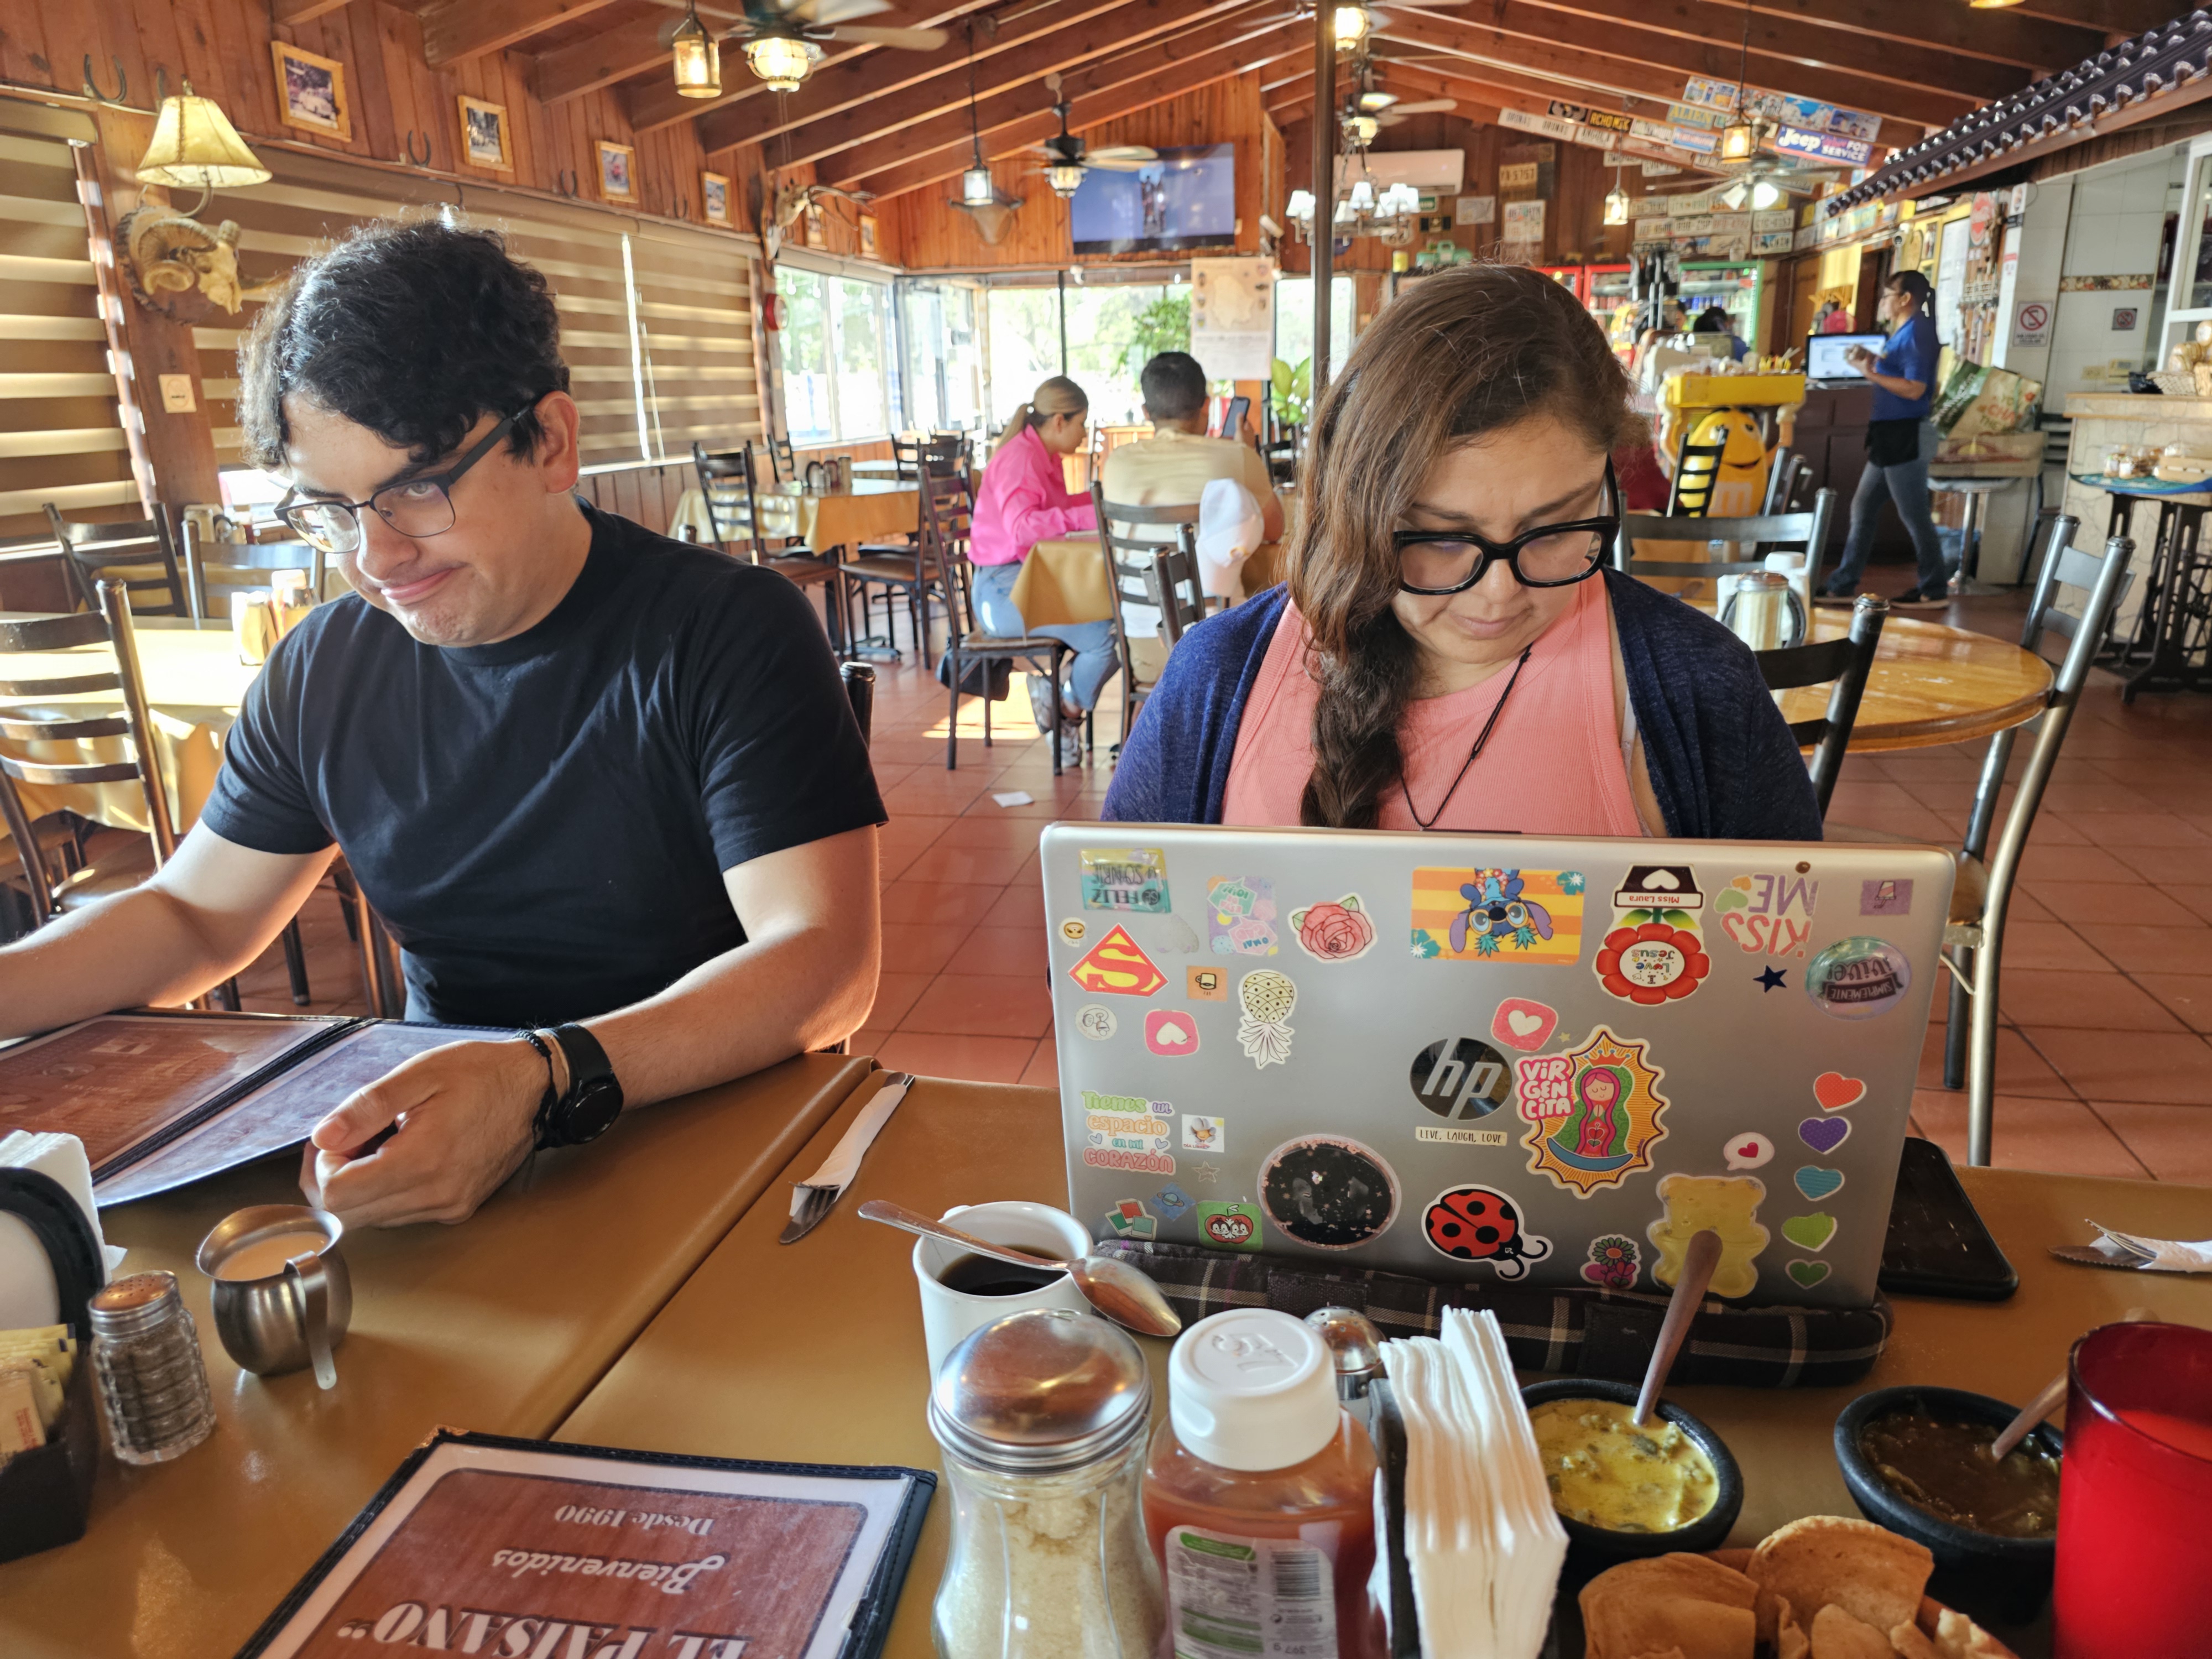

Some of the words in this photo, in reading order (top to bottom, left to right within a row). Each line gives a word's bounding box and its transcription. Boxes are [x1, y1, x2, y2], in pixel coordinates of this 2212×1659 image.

[1821, 145, 1866, 162] SERVICE
[1846, 140, 1869, 153] FOR
[1091, 889, 1139, 904] FELIZ
[1629, 895, 1655, 904] Laura
[1657, 895, 1679, 904] Miss
[1748, 875, 1819, 916] ME
[1242, 938, 1262, 950] MAI
[1722, 912, 1811, 958] KISS
[1631, 949, 1675, 961] Jesus
[1647, 974, 1656, 984] I
[1829, 982, 1893, 1000] SIMPLEMENTE
[1421, 1037, 1503, 1120] hp
[1522, 1080, 1568, 1099] GEN
[1081, 1091, 1146, 1113] Tienes
[1152, 1102, 1172, 1114] un
[1087, 1115, 1167, 1136] espacio
[1112, 1138, 1126, 1148] en
[1128, 1139, 1144, 1150] mi
[1420, 1129, 1442, 1140] LIVE,
[1447, 1131, 1477, 1142] LAUGH,
[1481, 1133, 1502, 1144] LOVE
[1084, 1149, 1173, 1173] CORAZÓN
[1212, 1333, 1299, 1373] 57
[555, 1504, 627, 1528] 1990
[632, 1511, 716, 1536] Desde
[492, 1548, 726, 1595] Bienvenidos
[1274, 1642, 1281, 1652] g
